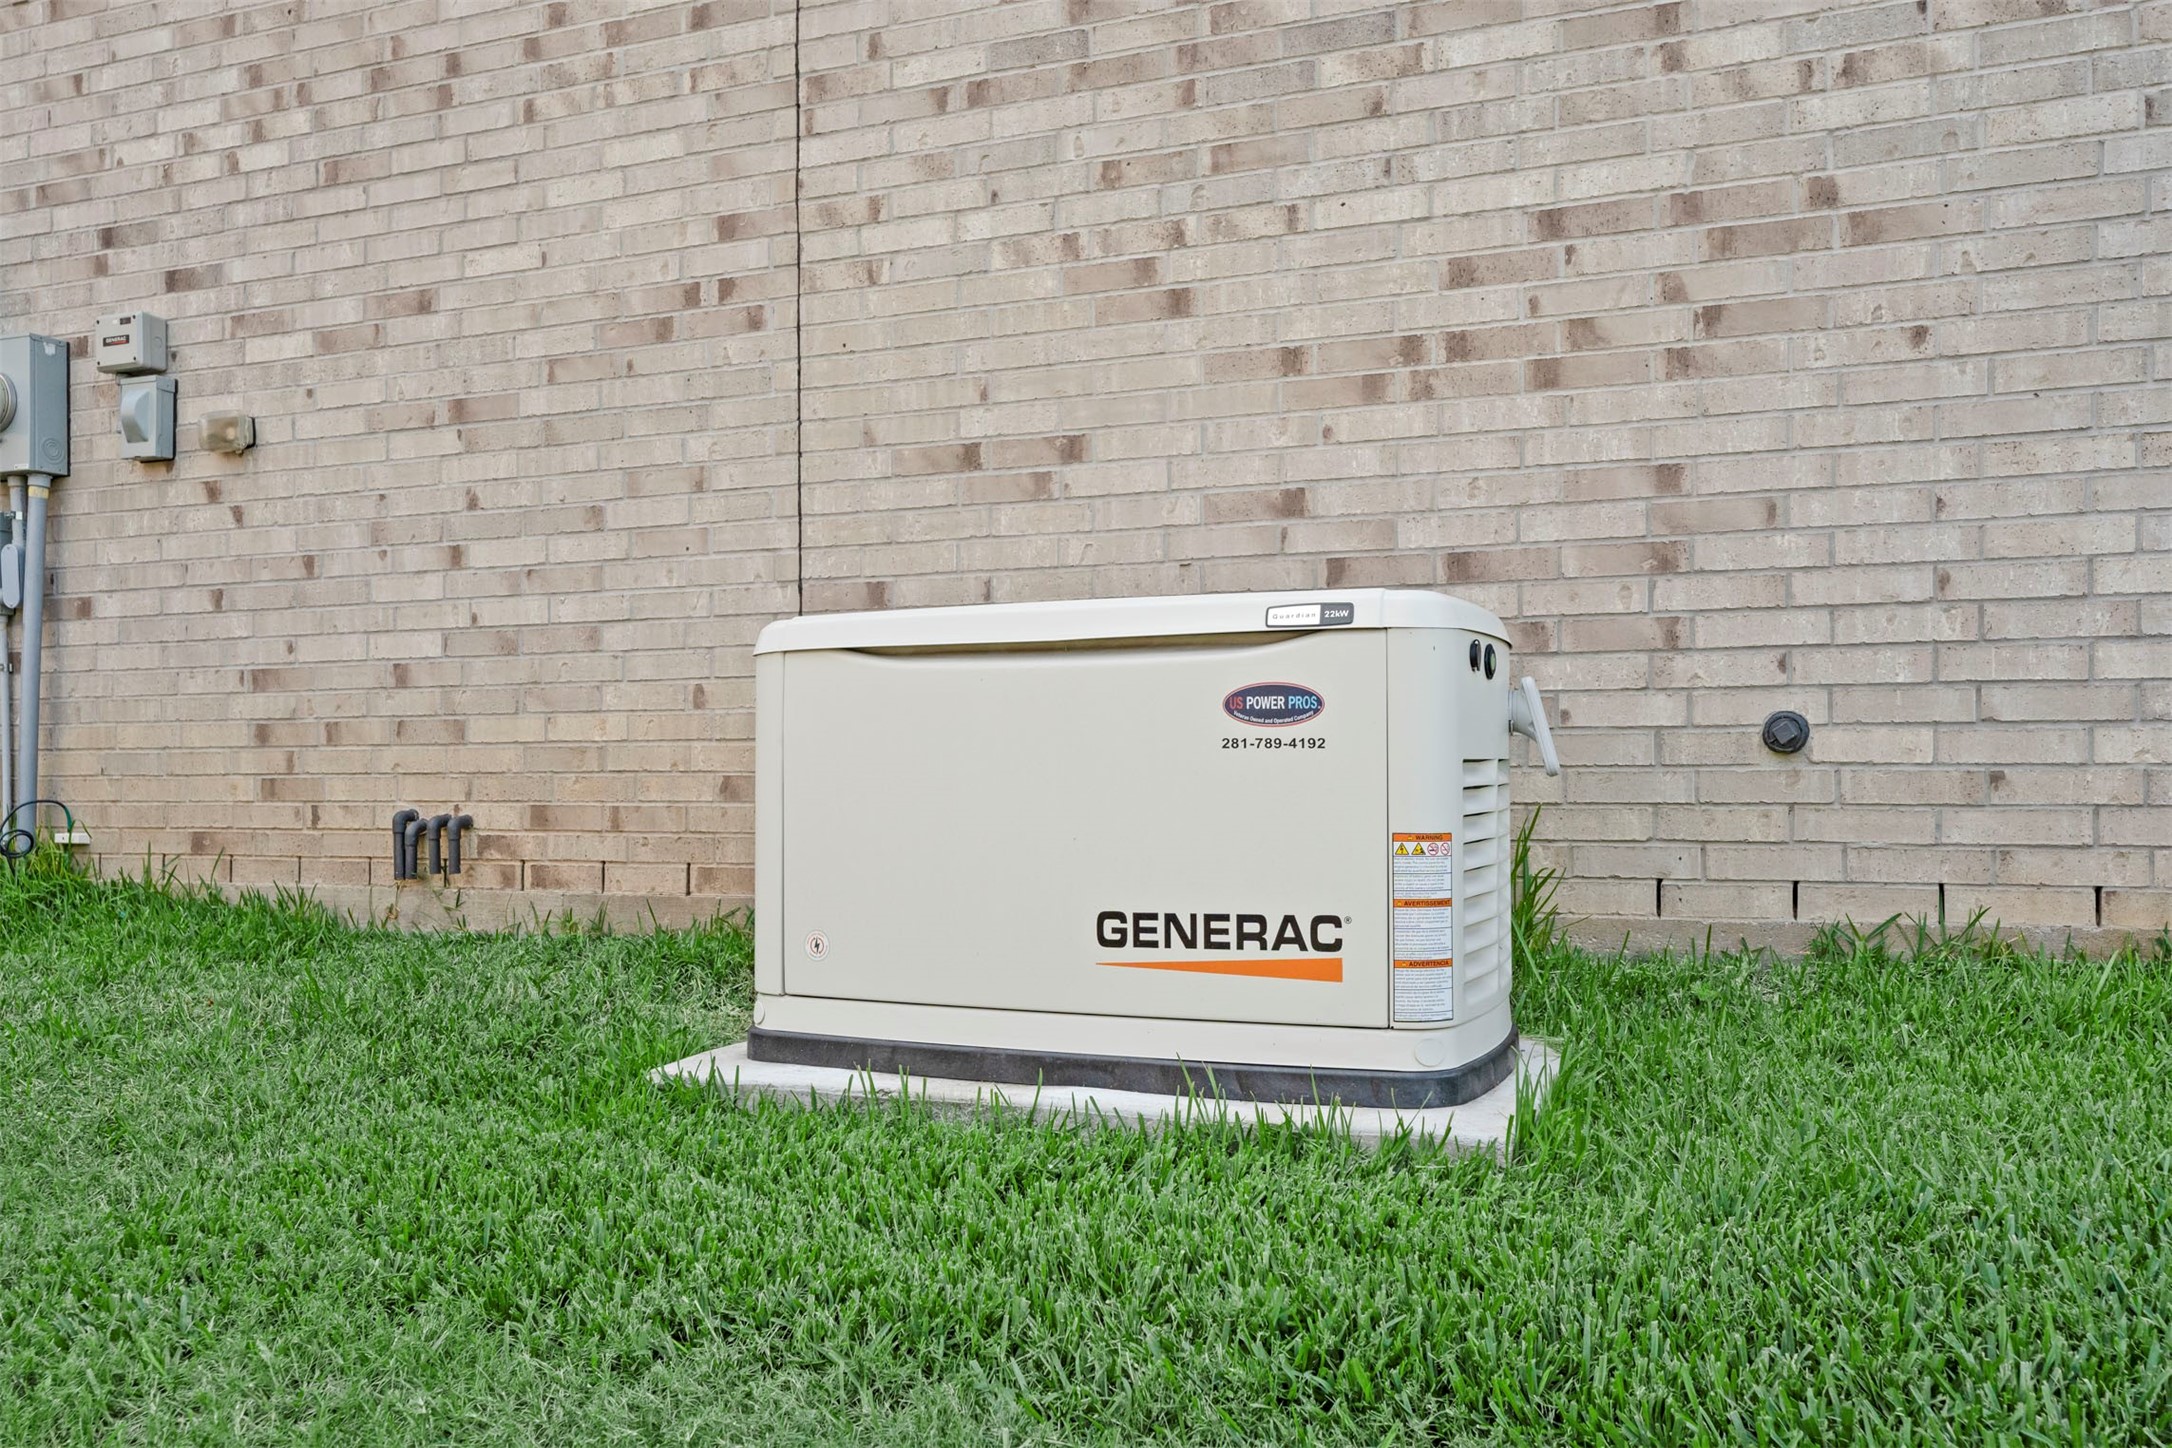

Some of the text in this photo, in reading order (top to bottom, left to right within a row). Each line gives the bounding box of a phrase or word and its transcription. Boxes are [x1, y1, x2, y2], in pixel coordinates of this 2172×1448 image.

[1272, 609, 1349, 620] Guardian 22kW
[1229, 696, 1243, 709] US
[1246, 696, 1285, 709] POWER
[1233, 710, 1249, 720] Veteran
[1249, 715, 1264, 723] Owned
[1273, 716, 1294, 724] Operated
[1294, 710, 1314, 721] Company
[1222, 738, 1326, 749] 281-789-4192
[1404, 899, 1450, 907] AVERTISSEMENT
